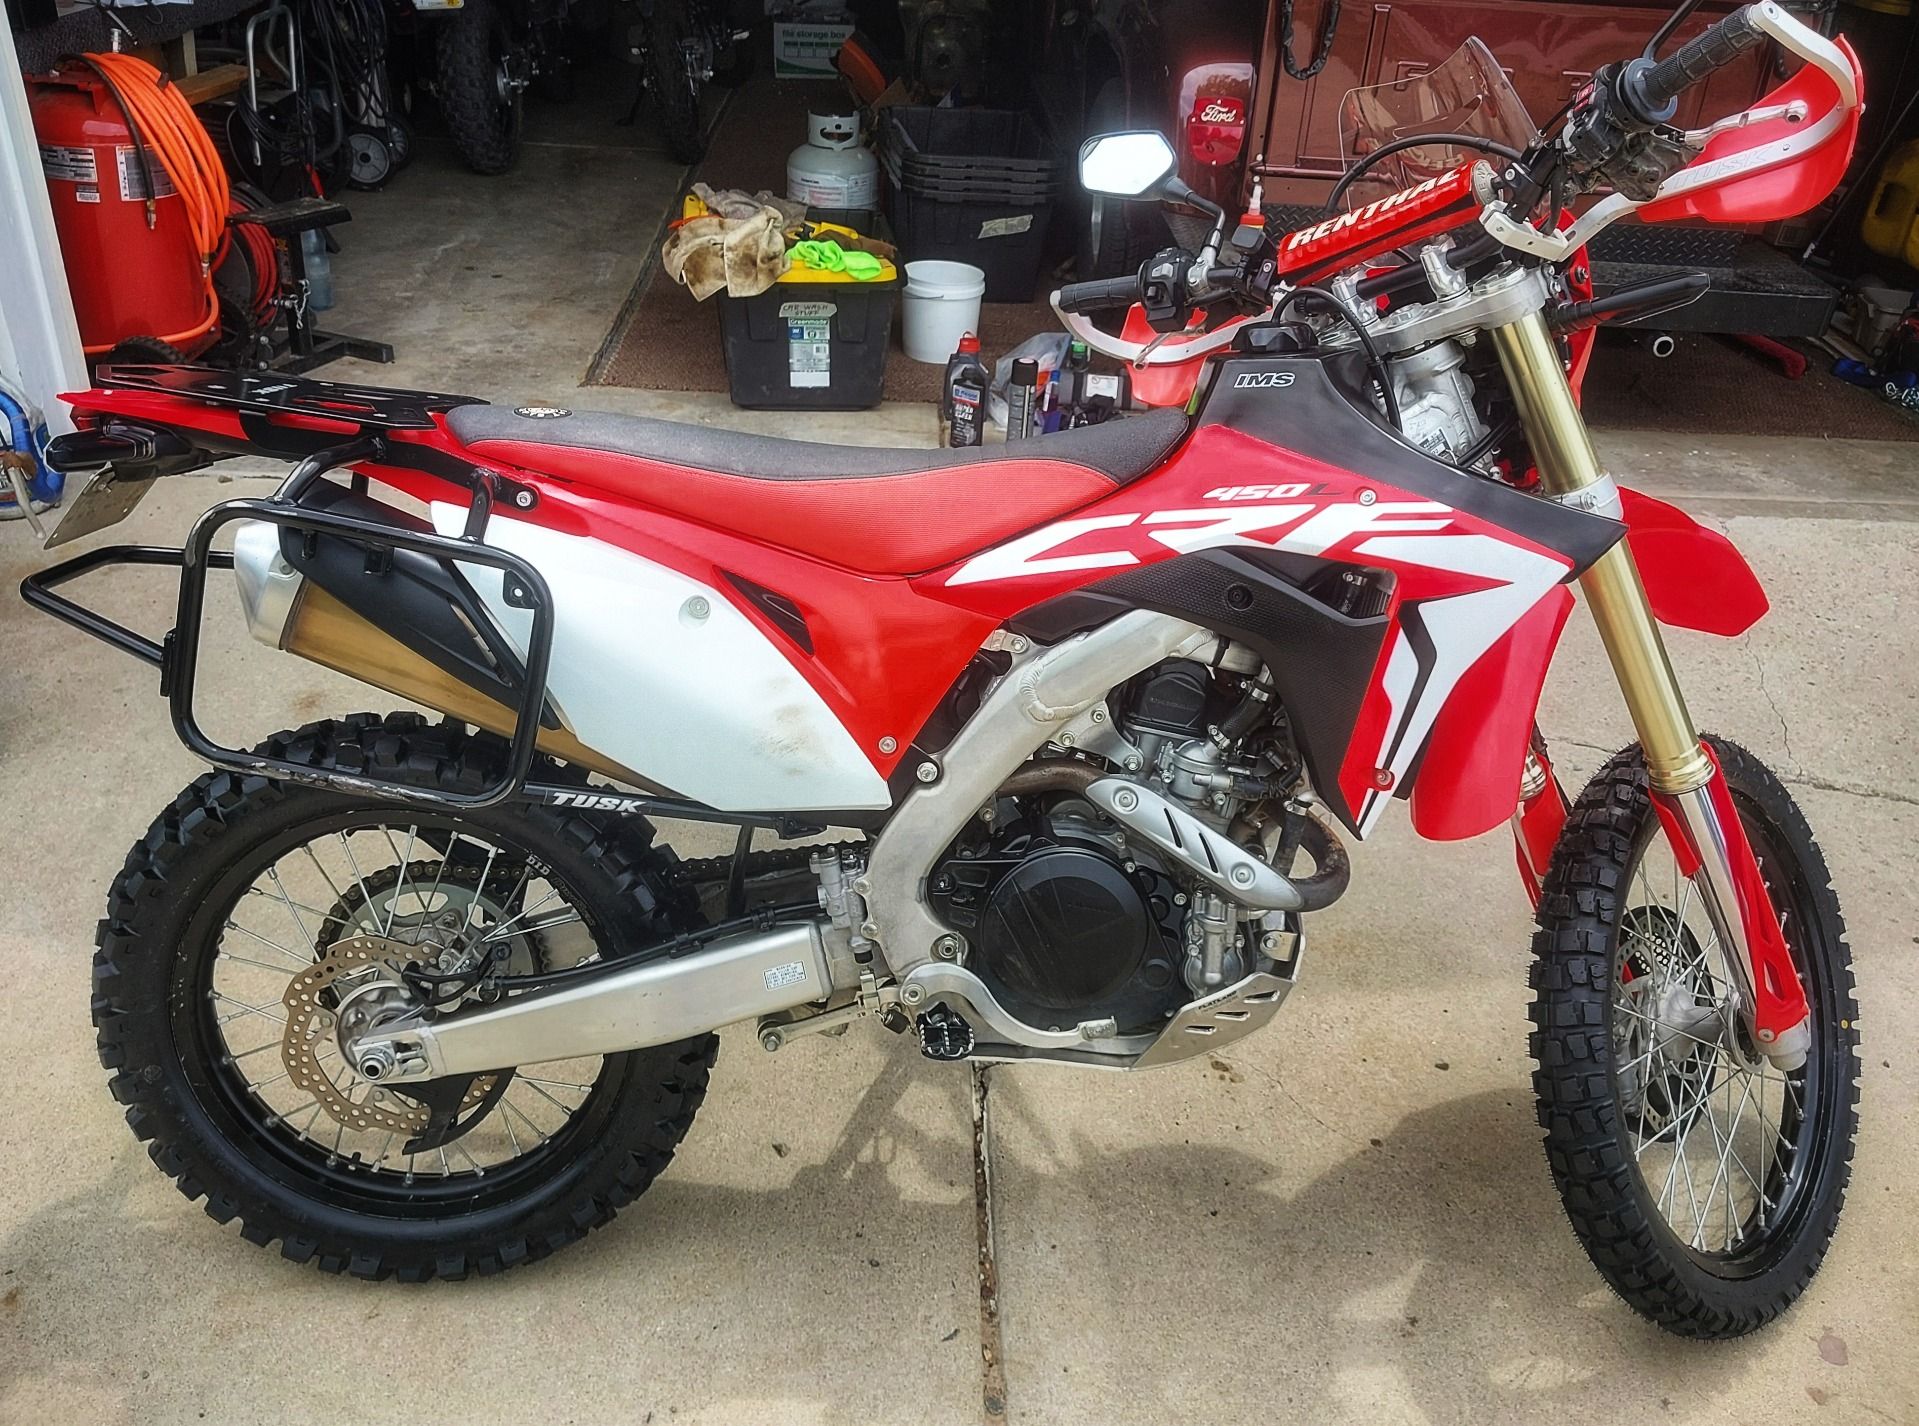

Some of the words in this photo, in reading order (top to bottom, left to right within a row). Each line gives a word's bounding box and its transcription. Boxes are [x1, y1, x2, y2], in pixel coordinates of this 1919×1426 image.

[797, 30, 829, 39] storage
[1200, 104, 1237, 123] Ford
[1671, 146, 1773, 188] TUSK
[1287, 168, 1462, 251] RENTHAL
[1234, 372, 1296, 388] IMS
[945, 502, 1454, 588] CRF
[552, 791, 647, 813] TUSK
